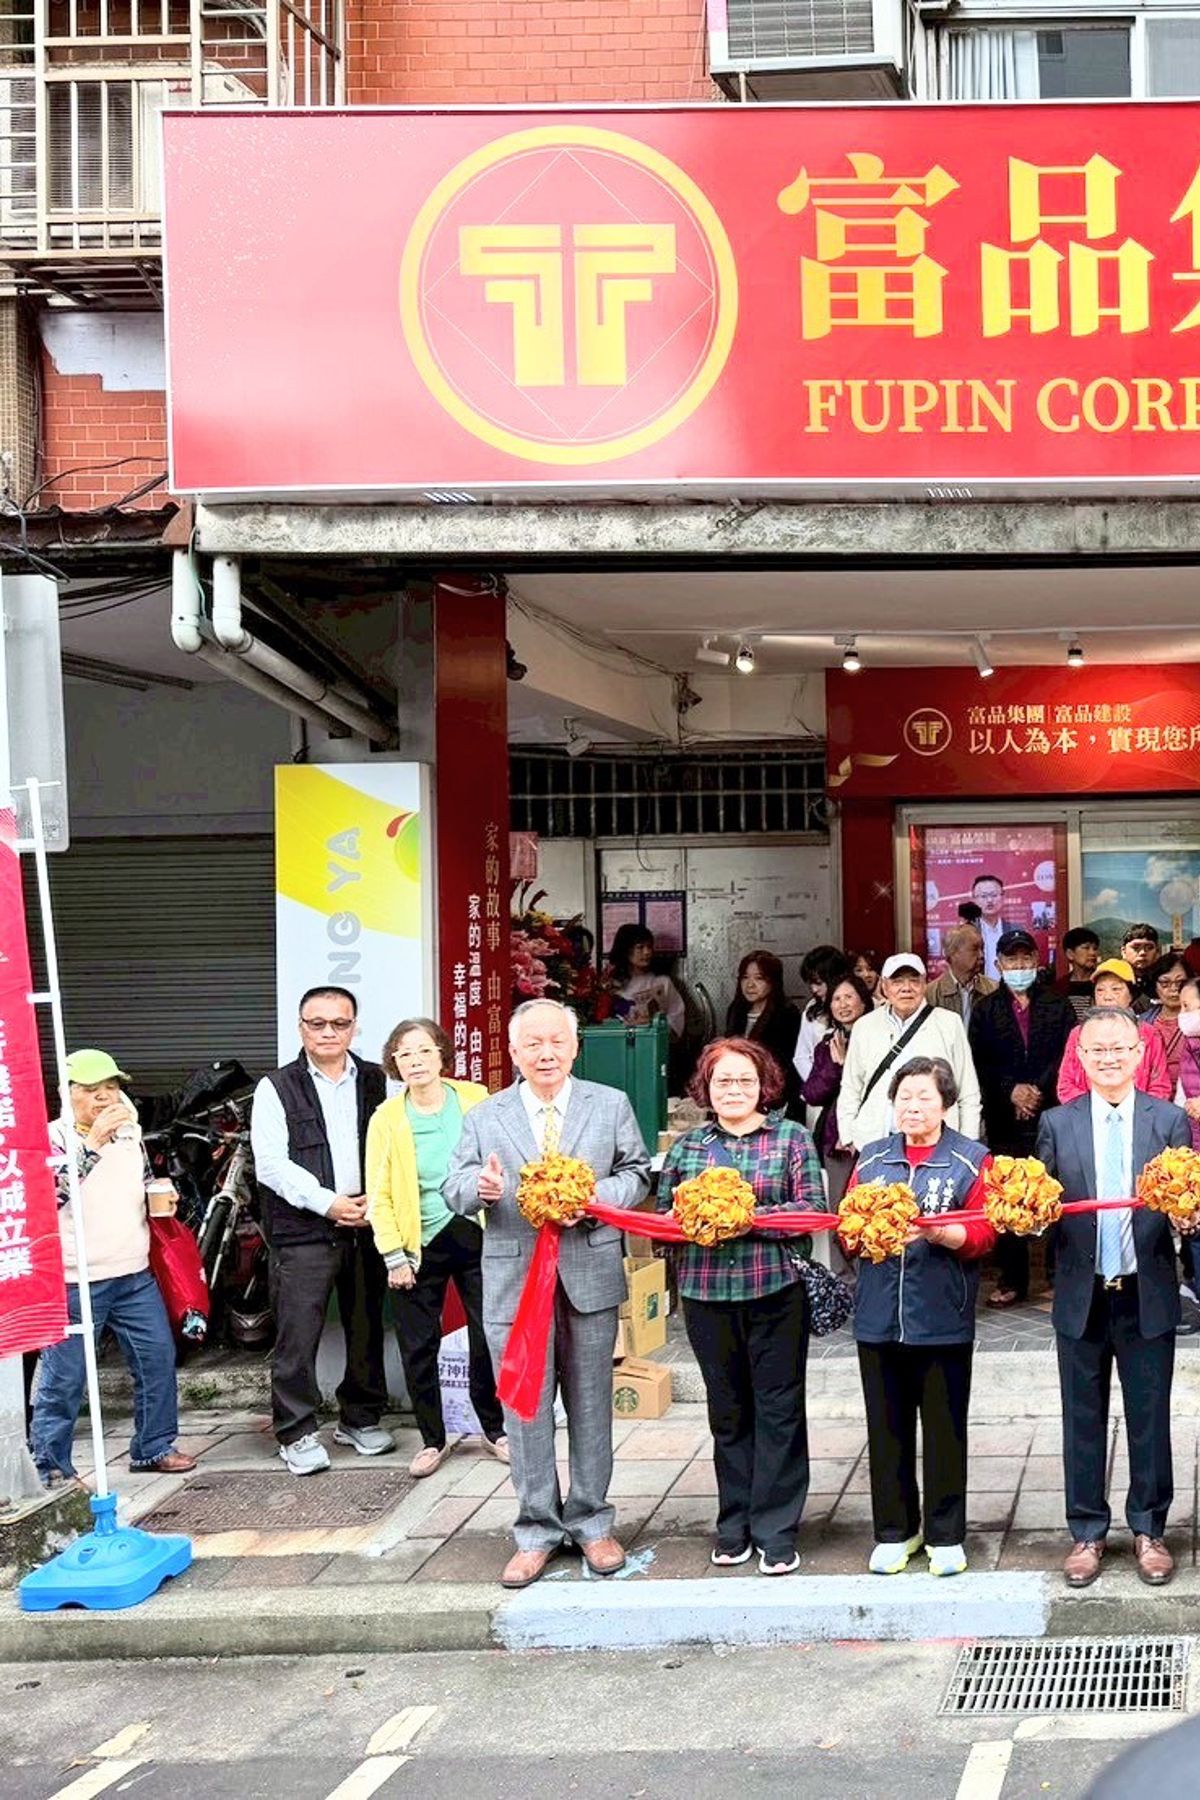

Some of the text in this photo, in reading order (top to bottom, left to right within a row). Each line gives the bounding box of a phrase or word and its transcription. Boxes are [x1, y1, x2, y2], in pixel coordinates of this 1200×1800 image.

[803, 378, 1016, 434] FUPIN
[968, 703, 1132, 725] 富品集團 富品建設
[326, 826, 362, 892] YA
[484, 821, 501, 952] 家的故事
